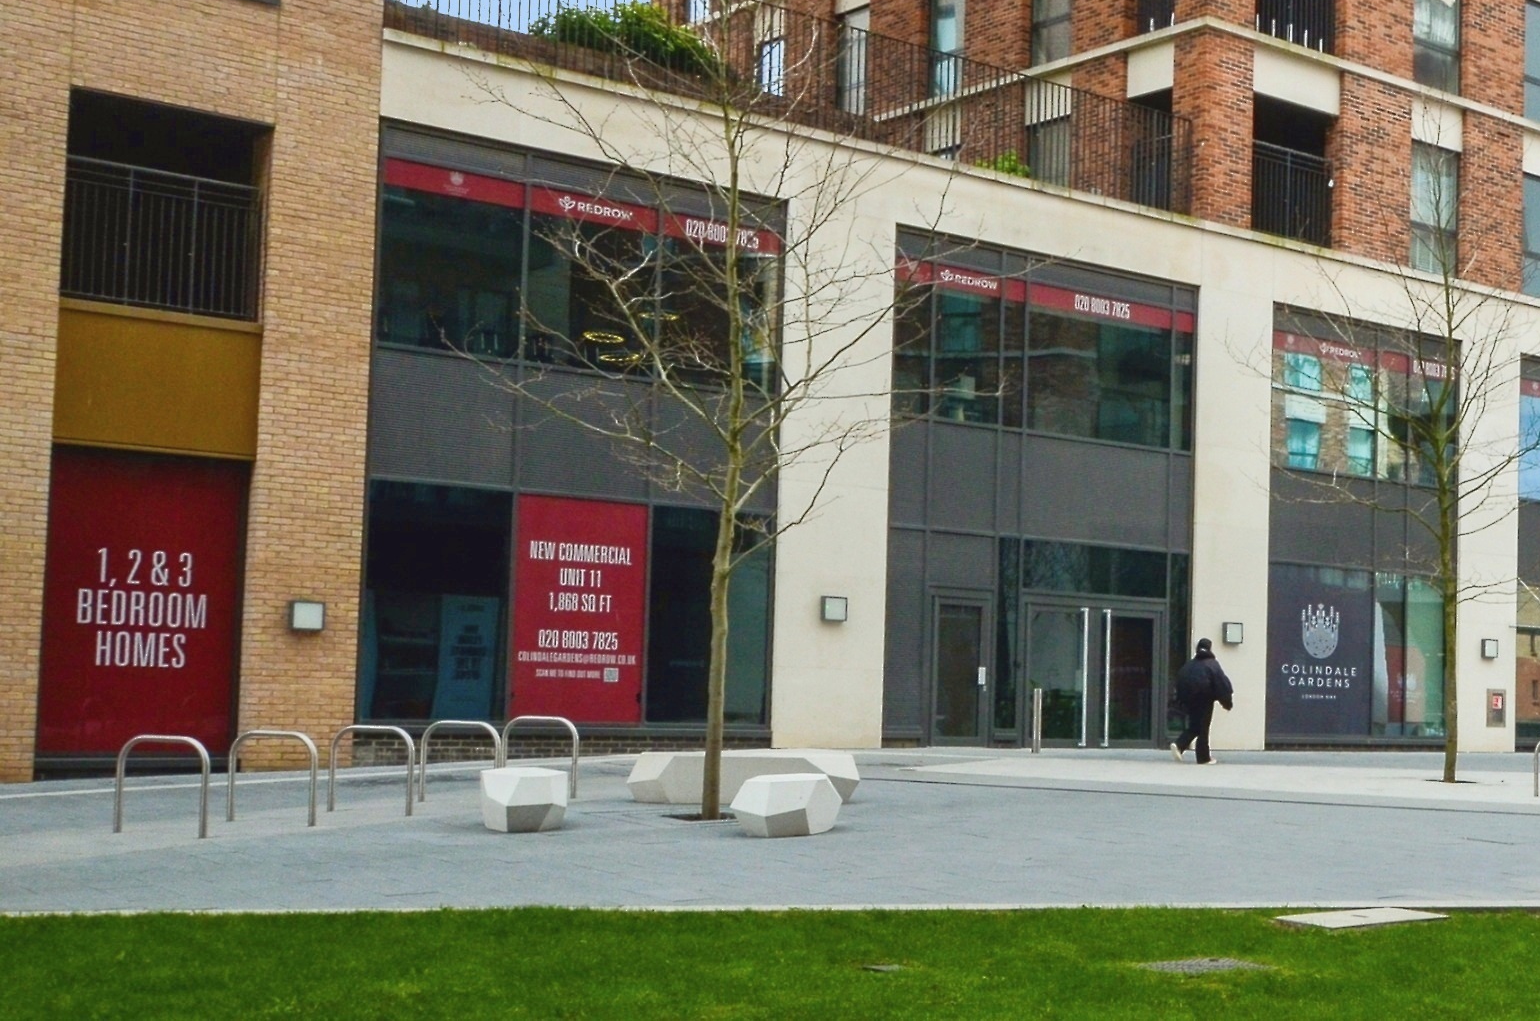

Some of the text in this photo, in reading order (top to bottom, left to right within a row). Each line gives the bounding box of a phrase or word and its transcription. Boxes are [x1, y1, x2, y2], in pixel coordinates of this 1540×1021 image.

[685, 218, 705, 239] 020
[707, 222, 731, 243] 800
[955, 274, 998, 290] REDROW
[1074, 294, 1090, 312] 020
[529, 539, 632, 566] NEW COMMERCIAL
[97, 547, 193, 588] 1, 2 & 3
[559, 567, 602, 588] UNIT 11
[76, 587, 208, 629] BEDROOM
[549, 591, 612, 614] 1,868 SQ FT
[94, 630, 187, 669] HOMES
[538, 629, 619, 651] 020 8003 7825
[1281, 663, 1358, 677] COLINDALE
[1288, 676, 1350, 689] GARDENS
